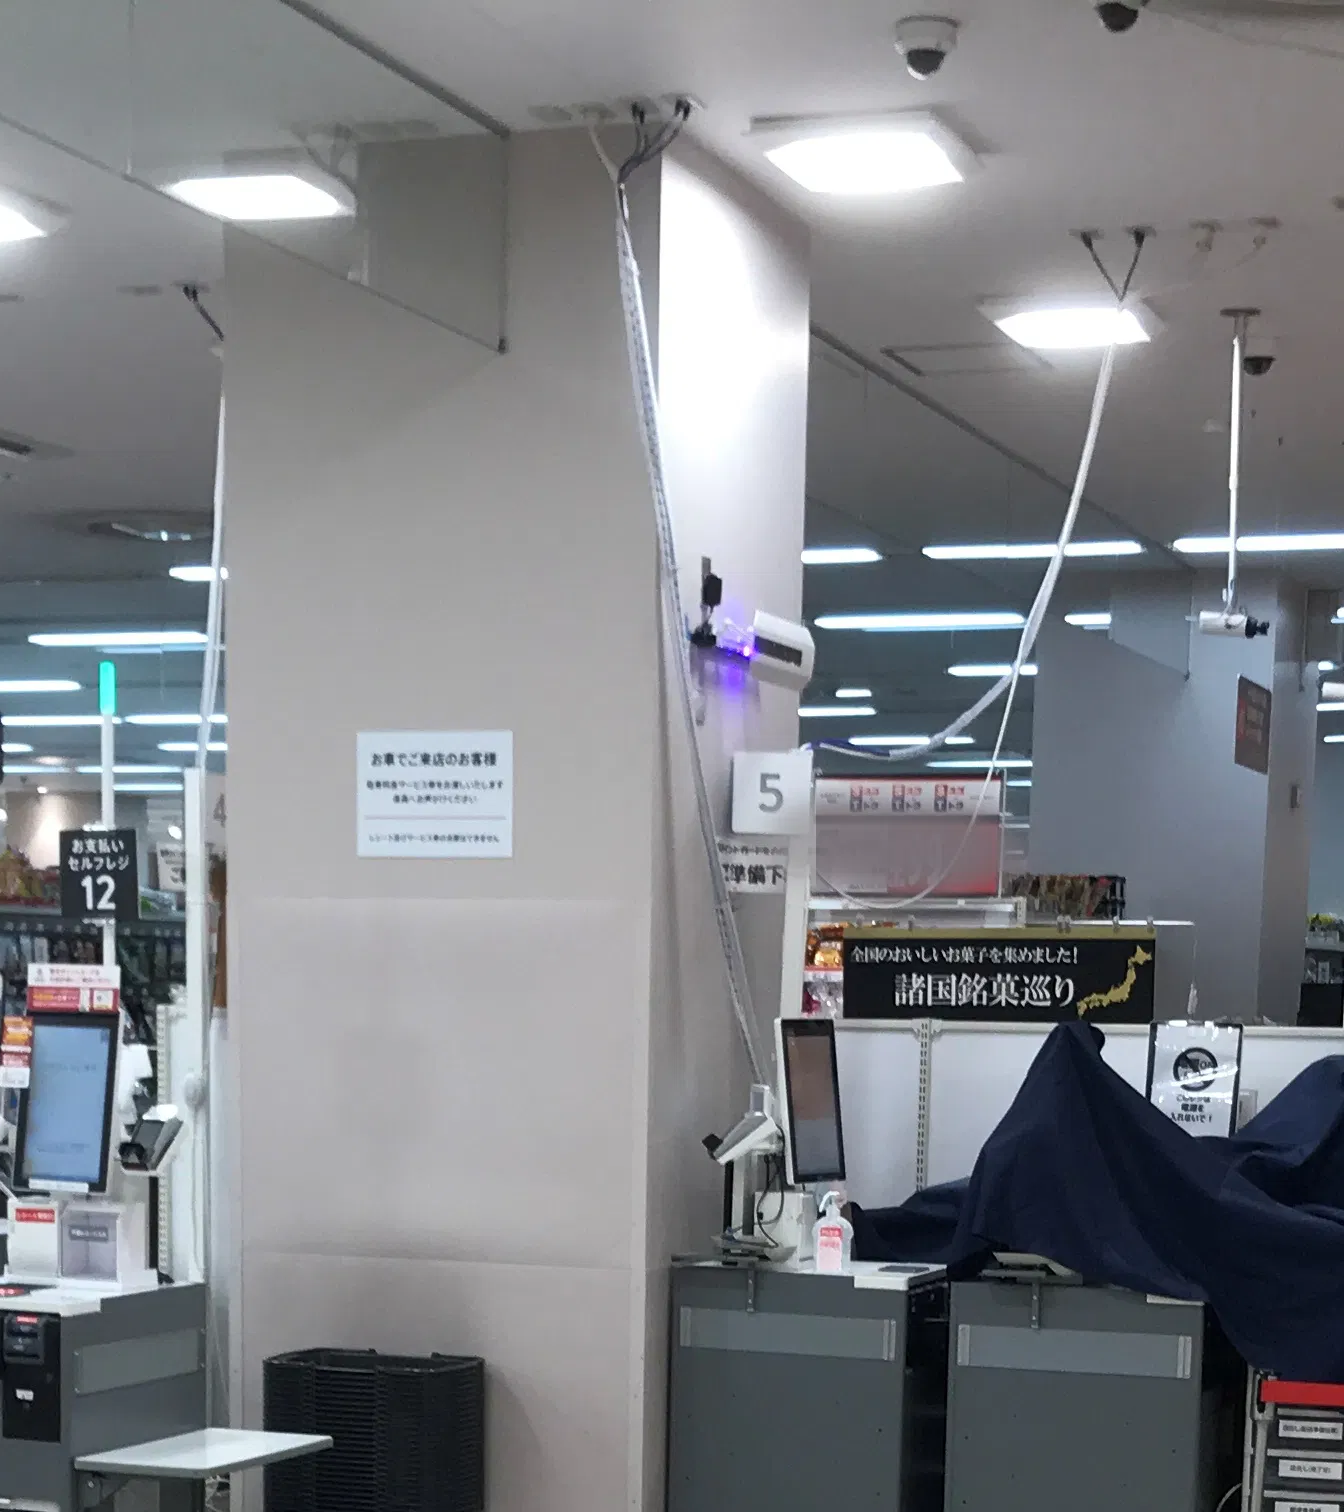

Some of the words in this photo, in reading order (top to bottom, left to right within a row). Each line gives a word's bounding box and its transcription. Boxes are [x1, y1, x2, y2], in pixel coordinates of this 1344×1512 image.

[758, 772, 784, 813] 5
[67, 855, 130, 872] セルフレジ
[71, 838, 125, 854] お支払い
[81, 875, 116, 911] 12
[894, 972, 1075, 1007] 諸国銘菓巡り
